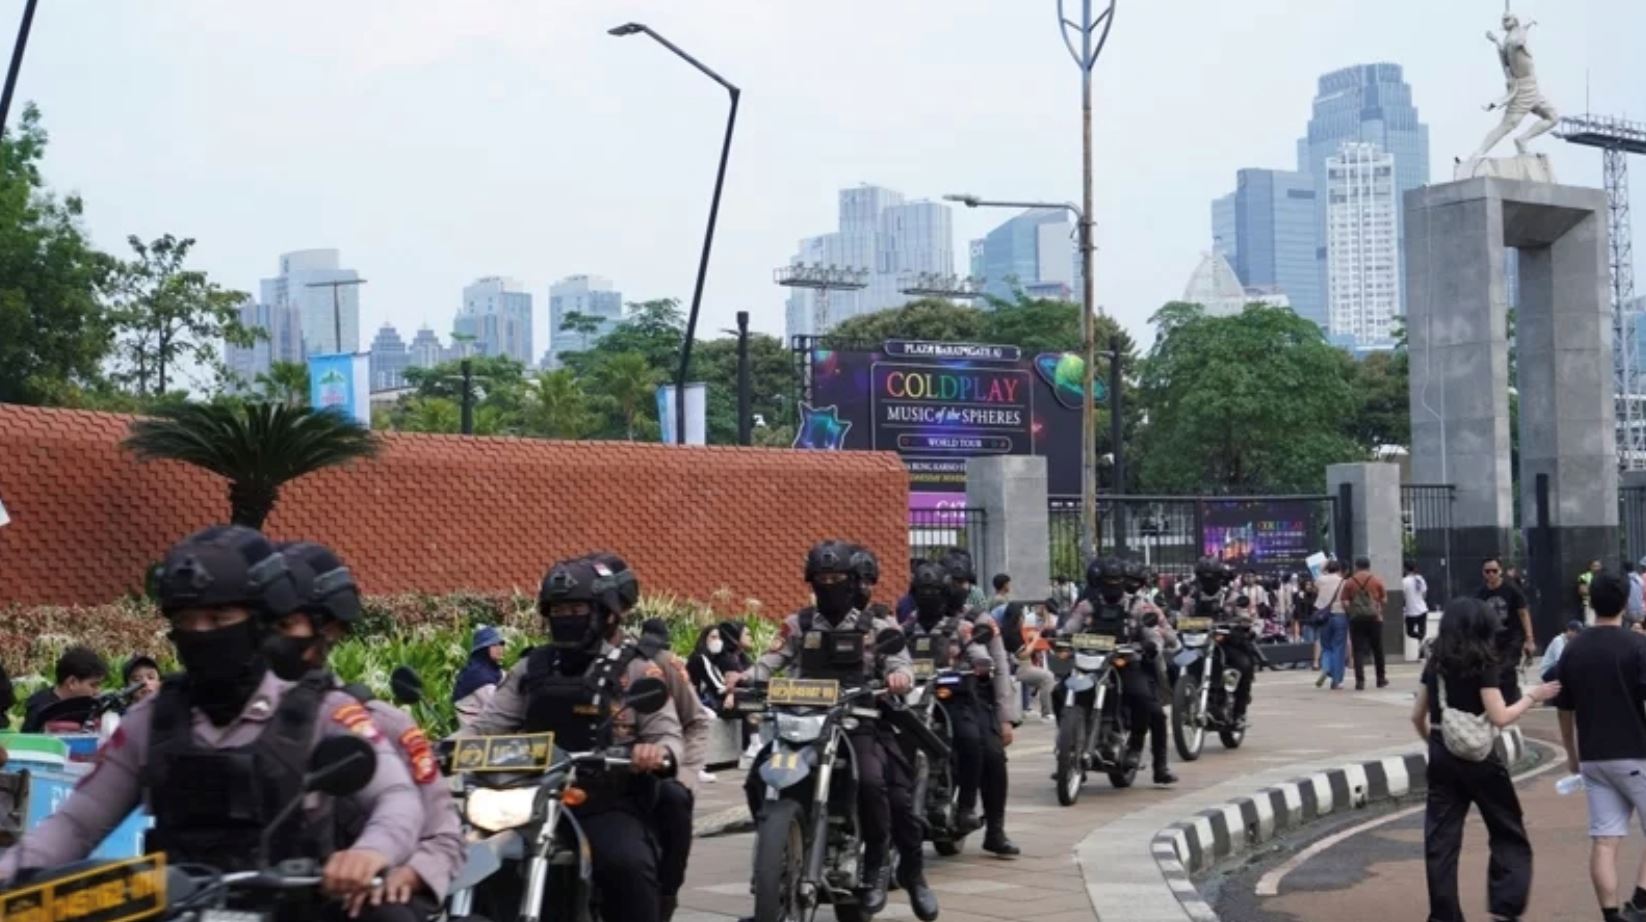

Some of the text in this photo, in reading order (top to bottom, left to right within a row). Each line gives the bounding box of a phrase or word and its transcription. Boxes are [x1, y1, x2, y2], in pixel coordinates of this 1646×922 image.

[887, 371, 1017, 402] COLDPLAY
[887, 407, 1021, 425] MUSIC of the SPHERES
[927, 438, 982, 448] WORLD TOUR
